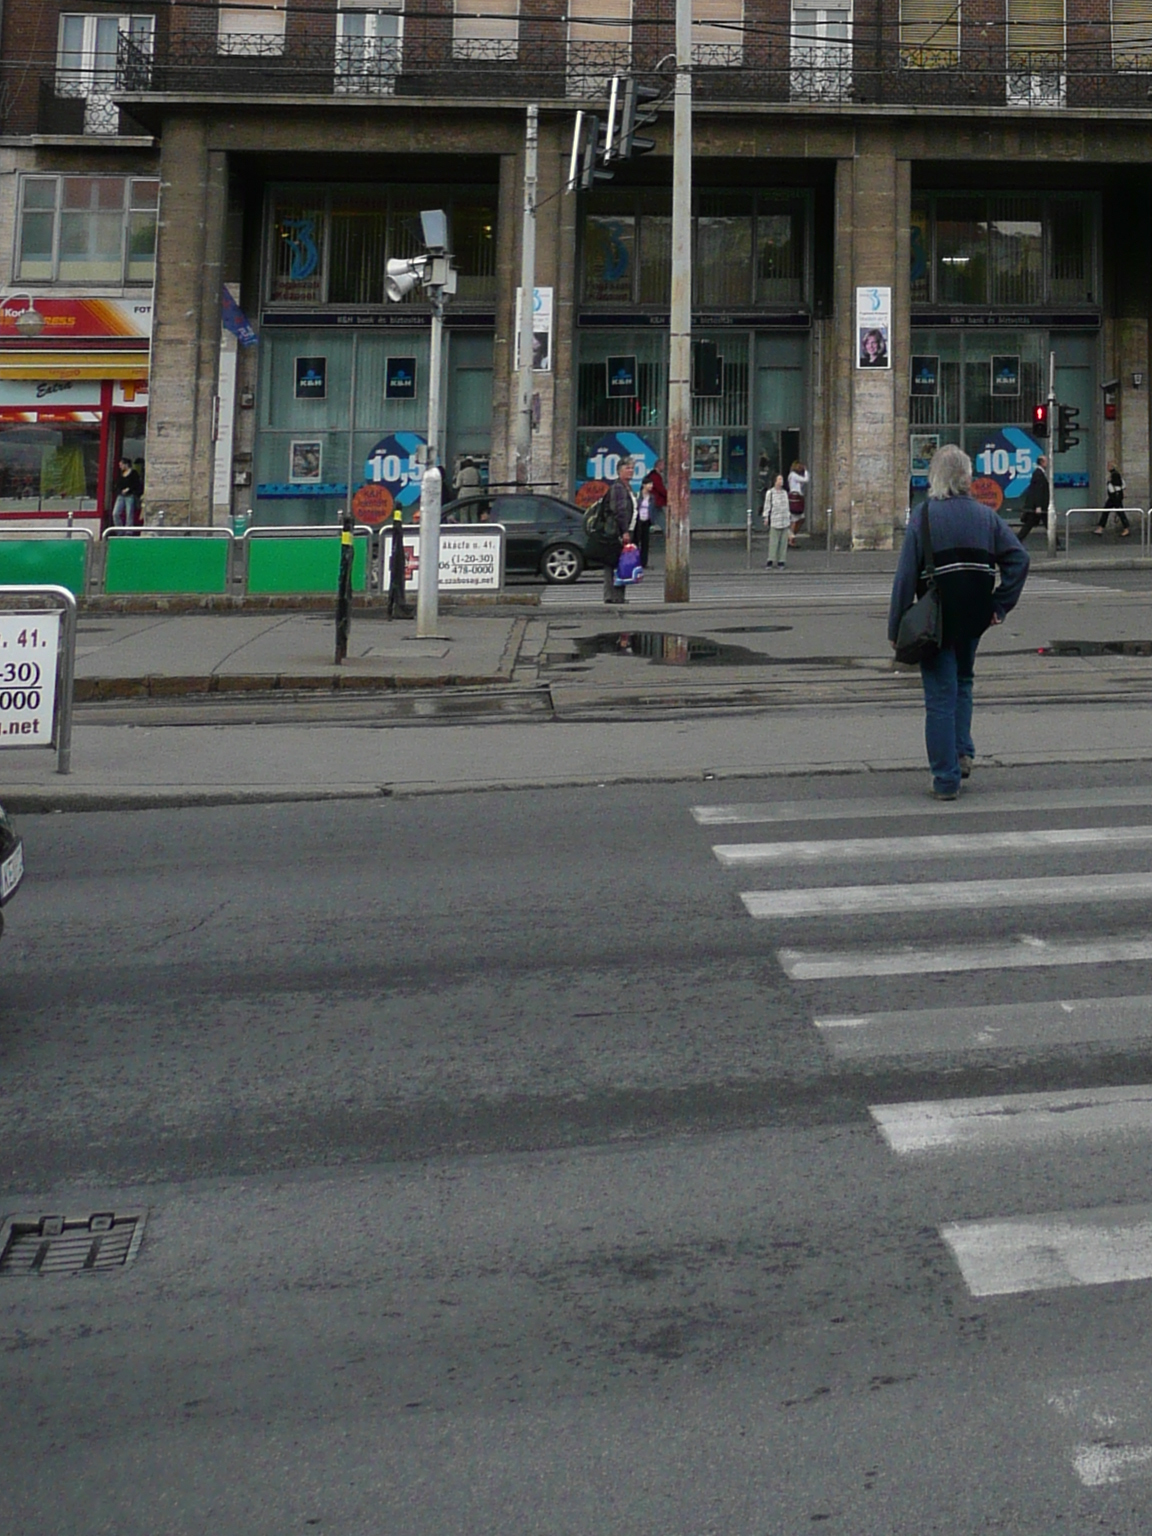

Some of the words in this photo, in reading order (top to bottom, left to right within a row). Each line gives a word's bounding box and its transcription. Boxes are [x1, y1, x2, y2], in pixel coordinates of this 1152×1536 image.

[36, 381, 73, 398] Extra
[589, 453, 646, 480] 105
[978, 448, 1032, 480] 10,5
[17, 628, 47, 648] 41.
[0, 718, 40, 735] .net
